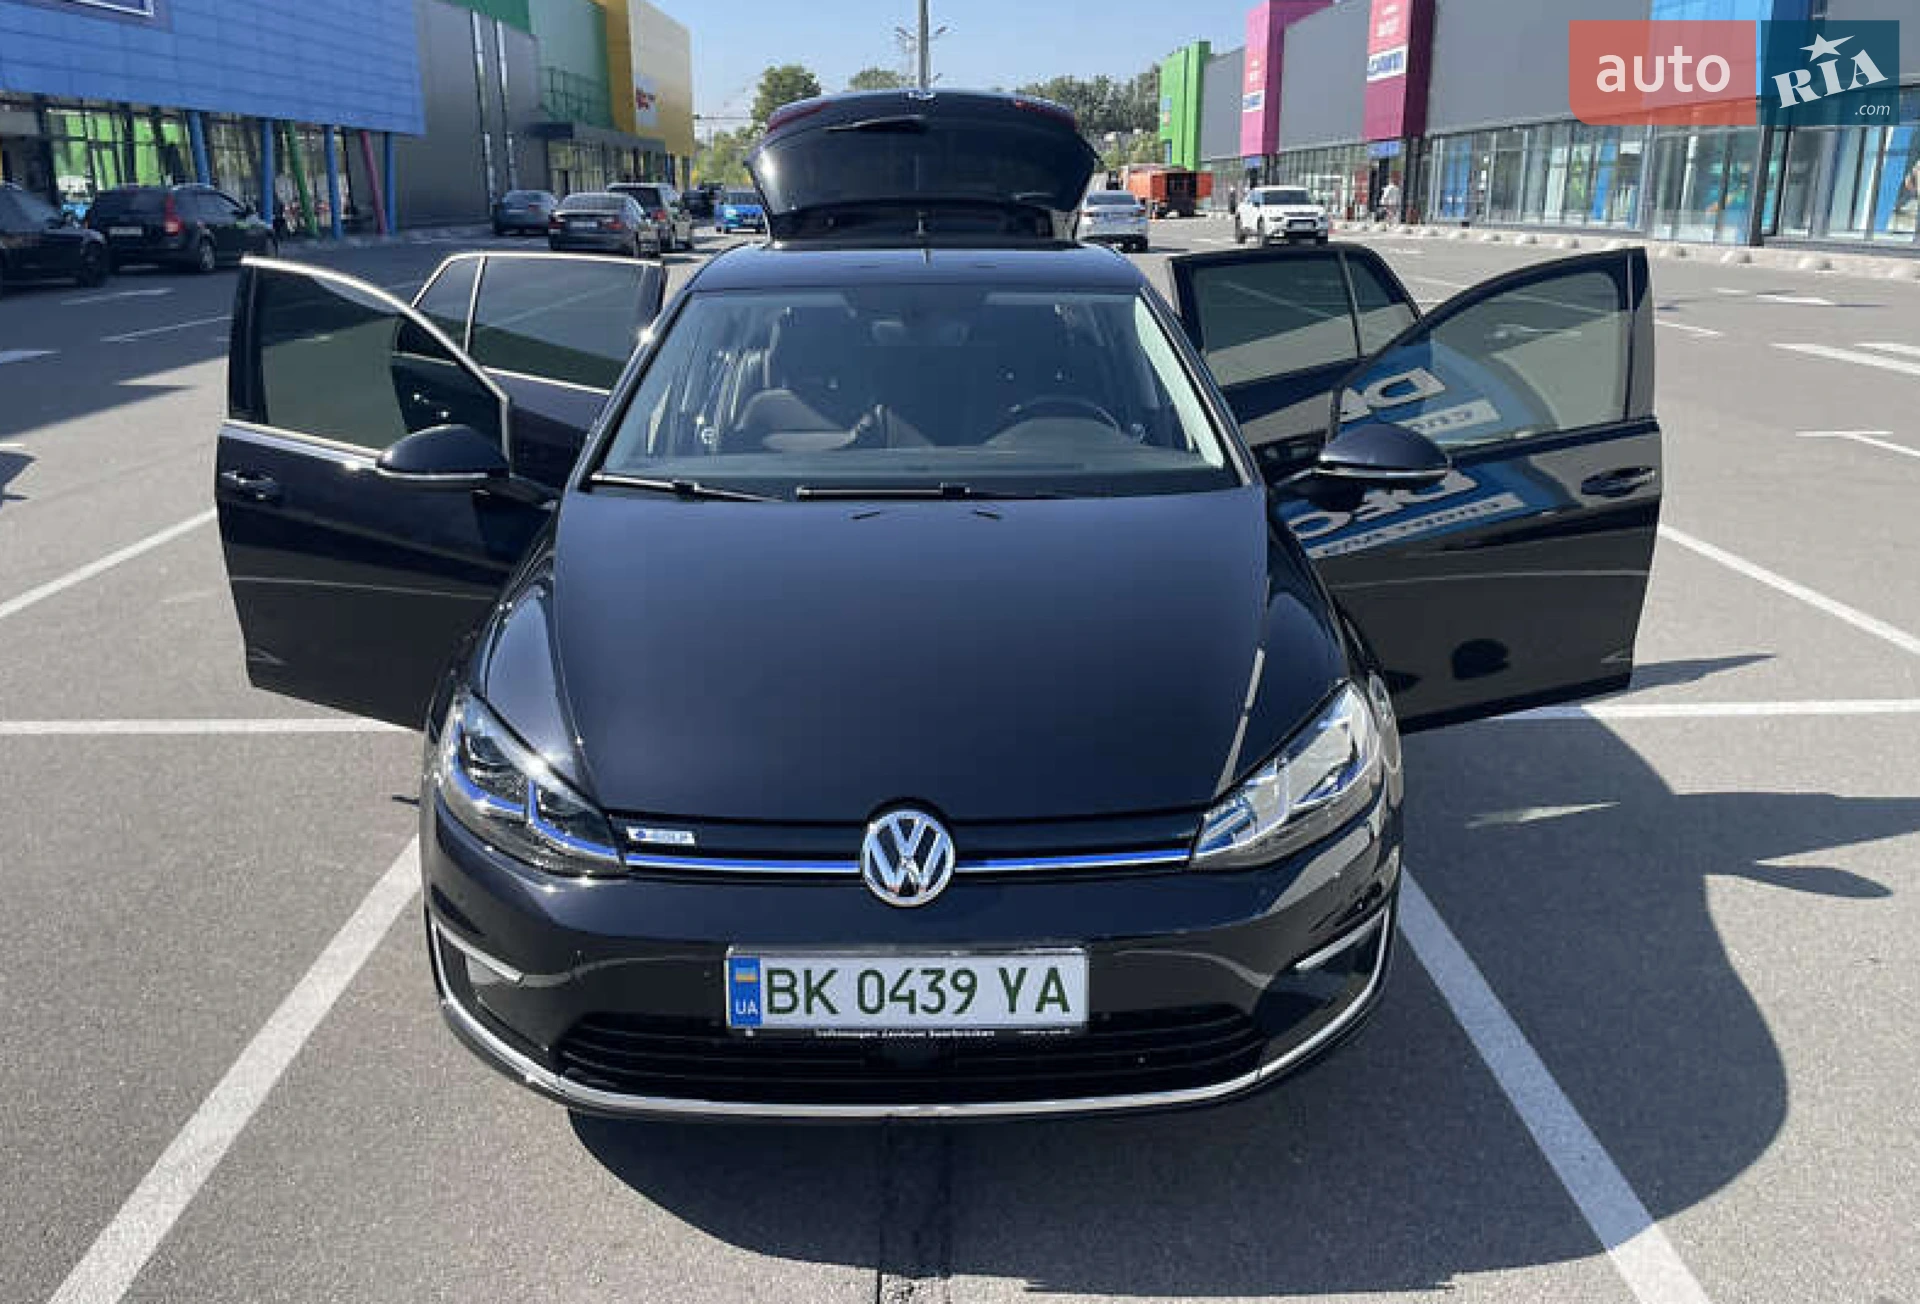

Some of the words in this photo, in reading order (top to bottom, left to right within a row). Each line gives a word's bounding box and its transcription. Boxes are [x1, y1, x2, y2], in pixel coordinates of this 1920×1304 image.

[735, 999, 759, 1015] UA
[766, 967, 839, 1015] BK
[857, 967, 978, 1015] 0439
[998, 967, 1070, 1014] YA
